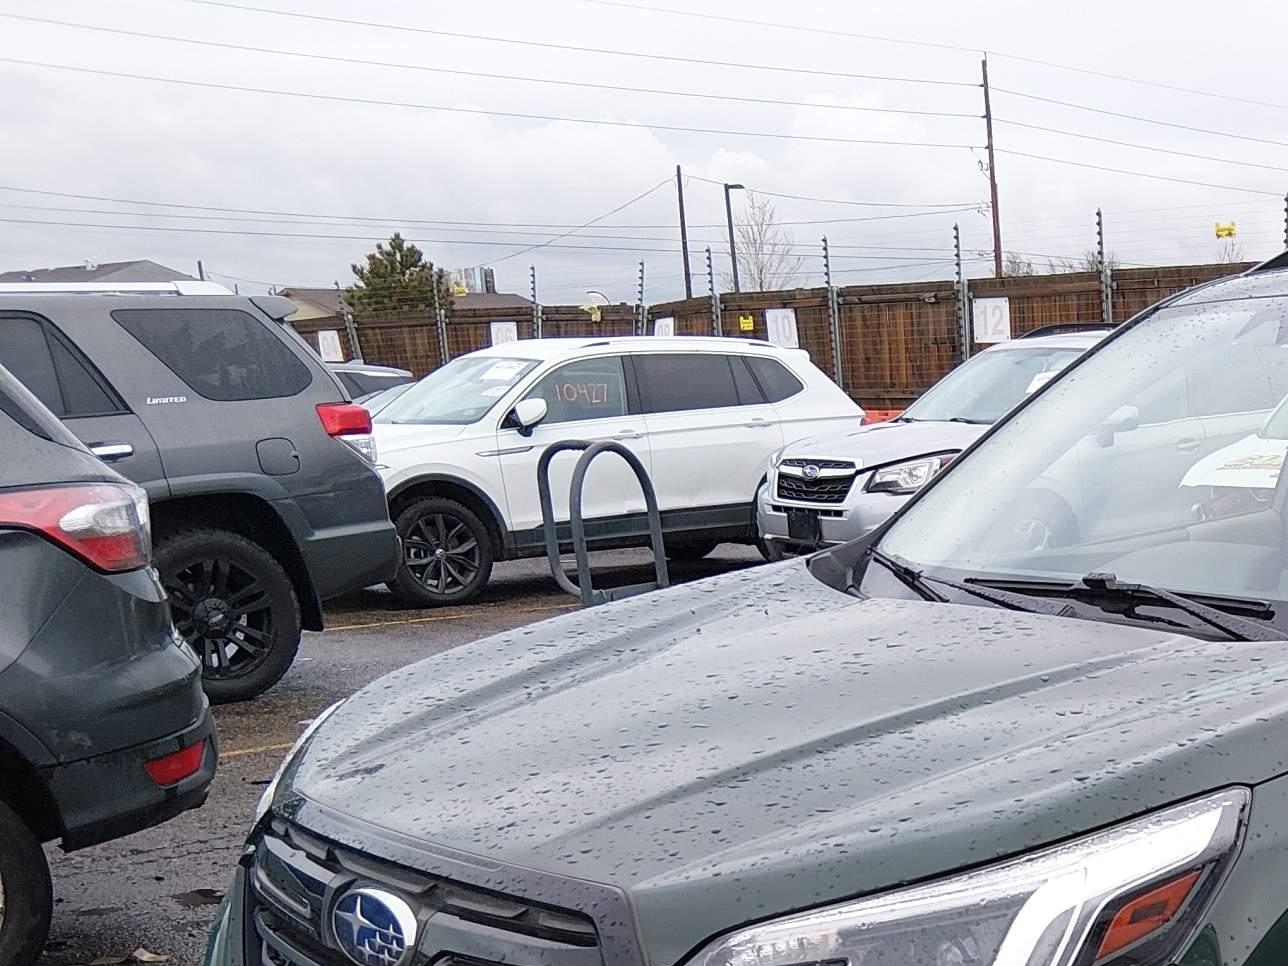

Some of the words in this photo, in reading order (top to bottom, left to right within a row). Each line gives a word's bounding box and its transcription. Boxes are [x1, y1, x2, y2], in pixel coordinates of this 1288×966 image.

[773, 313, 794, 342] 10
[980, 305, 1006, 336] 12
[555, 383, 608, 403] 10427
